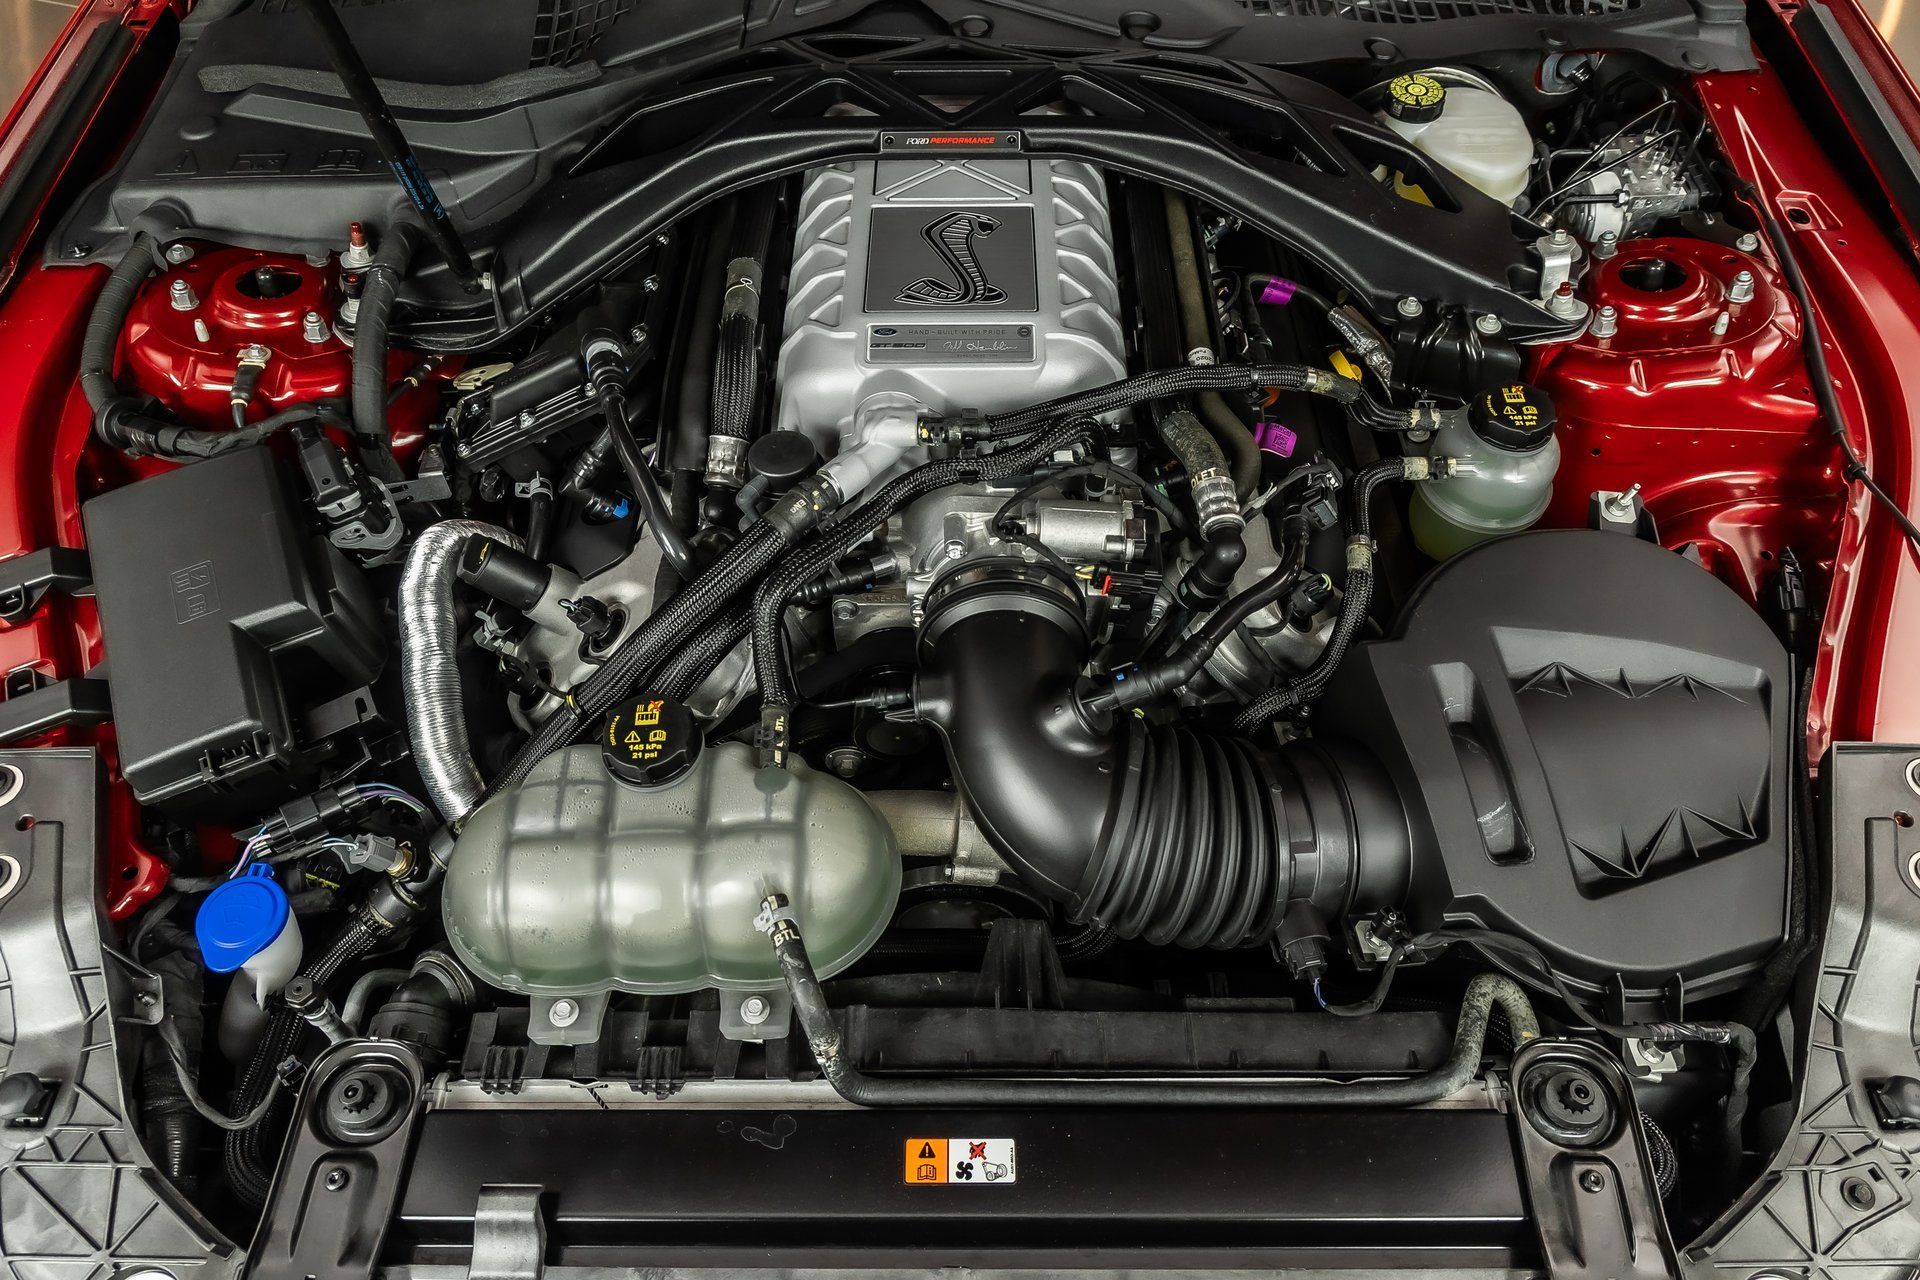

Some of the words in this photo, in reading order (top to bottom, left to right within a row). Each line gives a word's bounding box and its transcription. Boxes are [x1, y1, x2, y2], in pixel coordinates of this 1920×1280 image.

[906, 137, 929, 145] FORD
[929, 136, 996, 145] PERFORMANCE
[790, 499, 807, 514] ENG
[774, 715, 785, 732] BTL
[644, 751, 658, 759] psi
[773, 929, 800, 947] BTL
